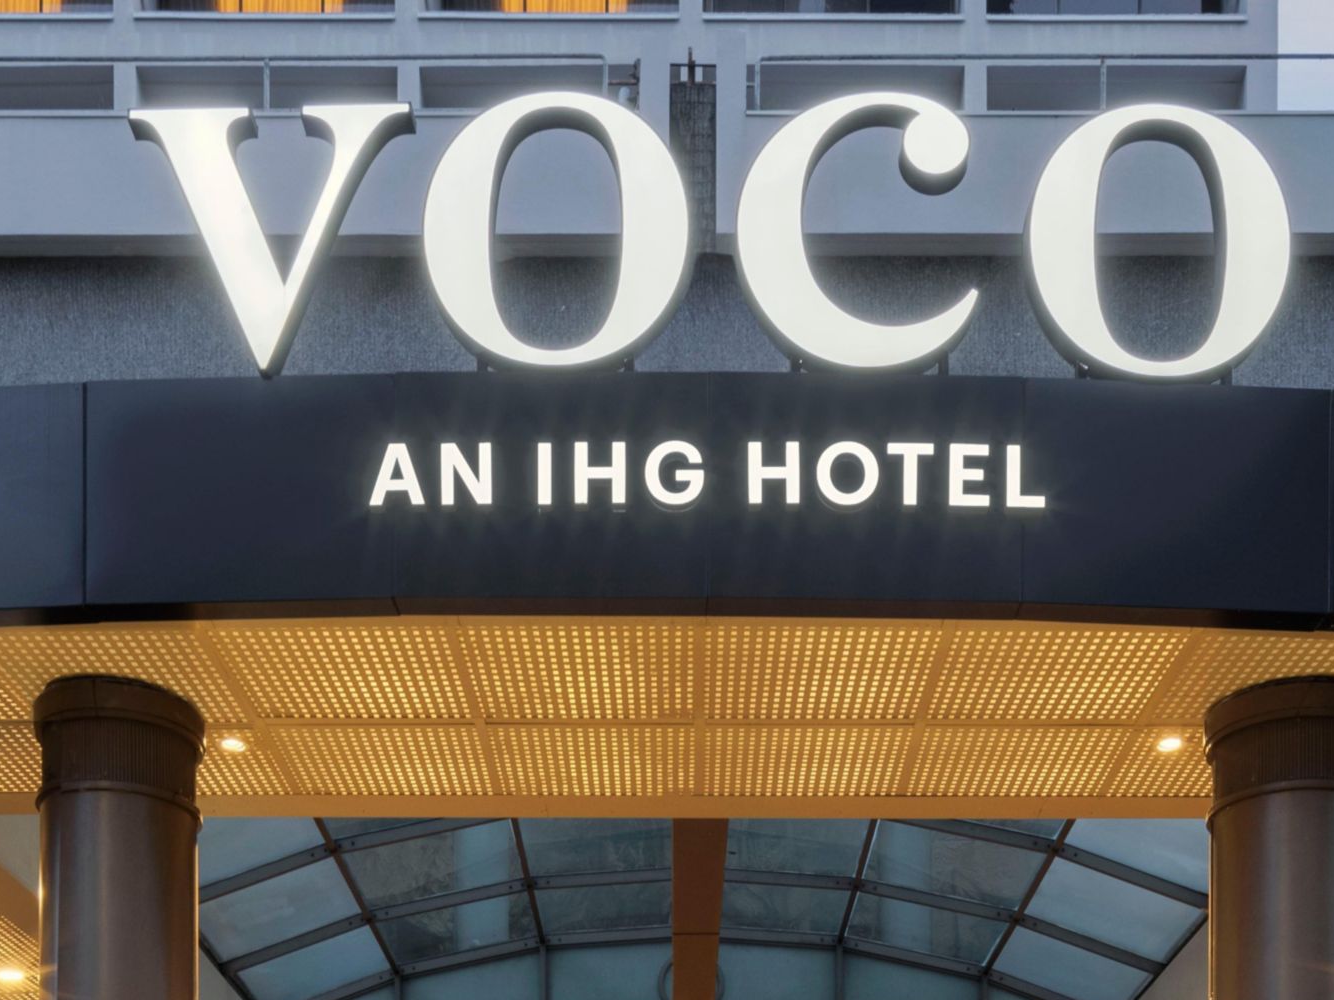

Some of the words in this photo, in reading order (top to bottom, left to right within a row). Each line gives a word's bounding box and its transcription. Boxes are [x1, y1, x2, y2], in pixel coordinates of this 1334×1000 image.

[128, 90, 1292, 381] VOCO
[369, 443, 492, 505] AN
[537, 441, 705, 506] IHG
[747, 442, 1046, 508] HOTEL
